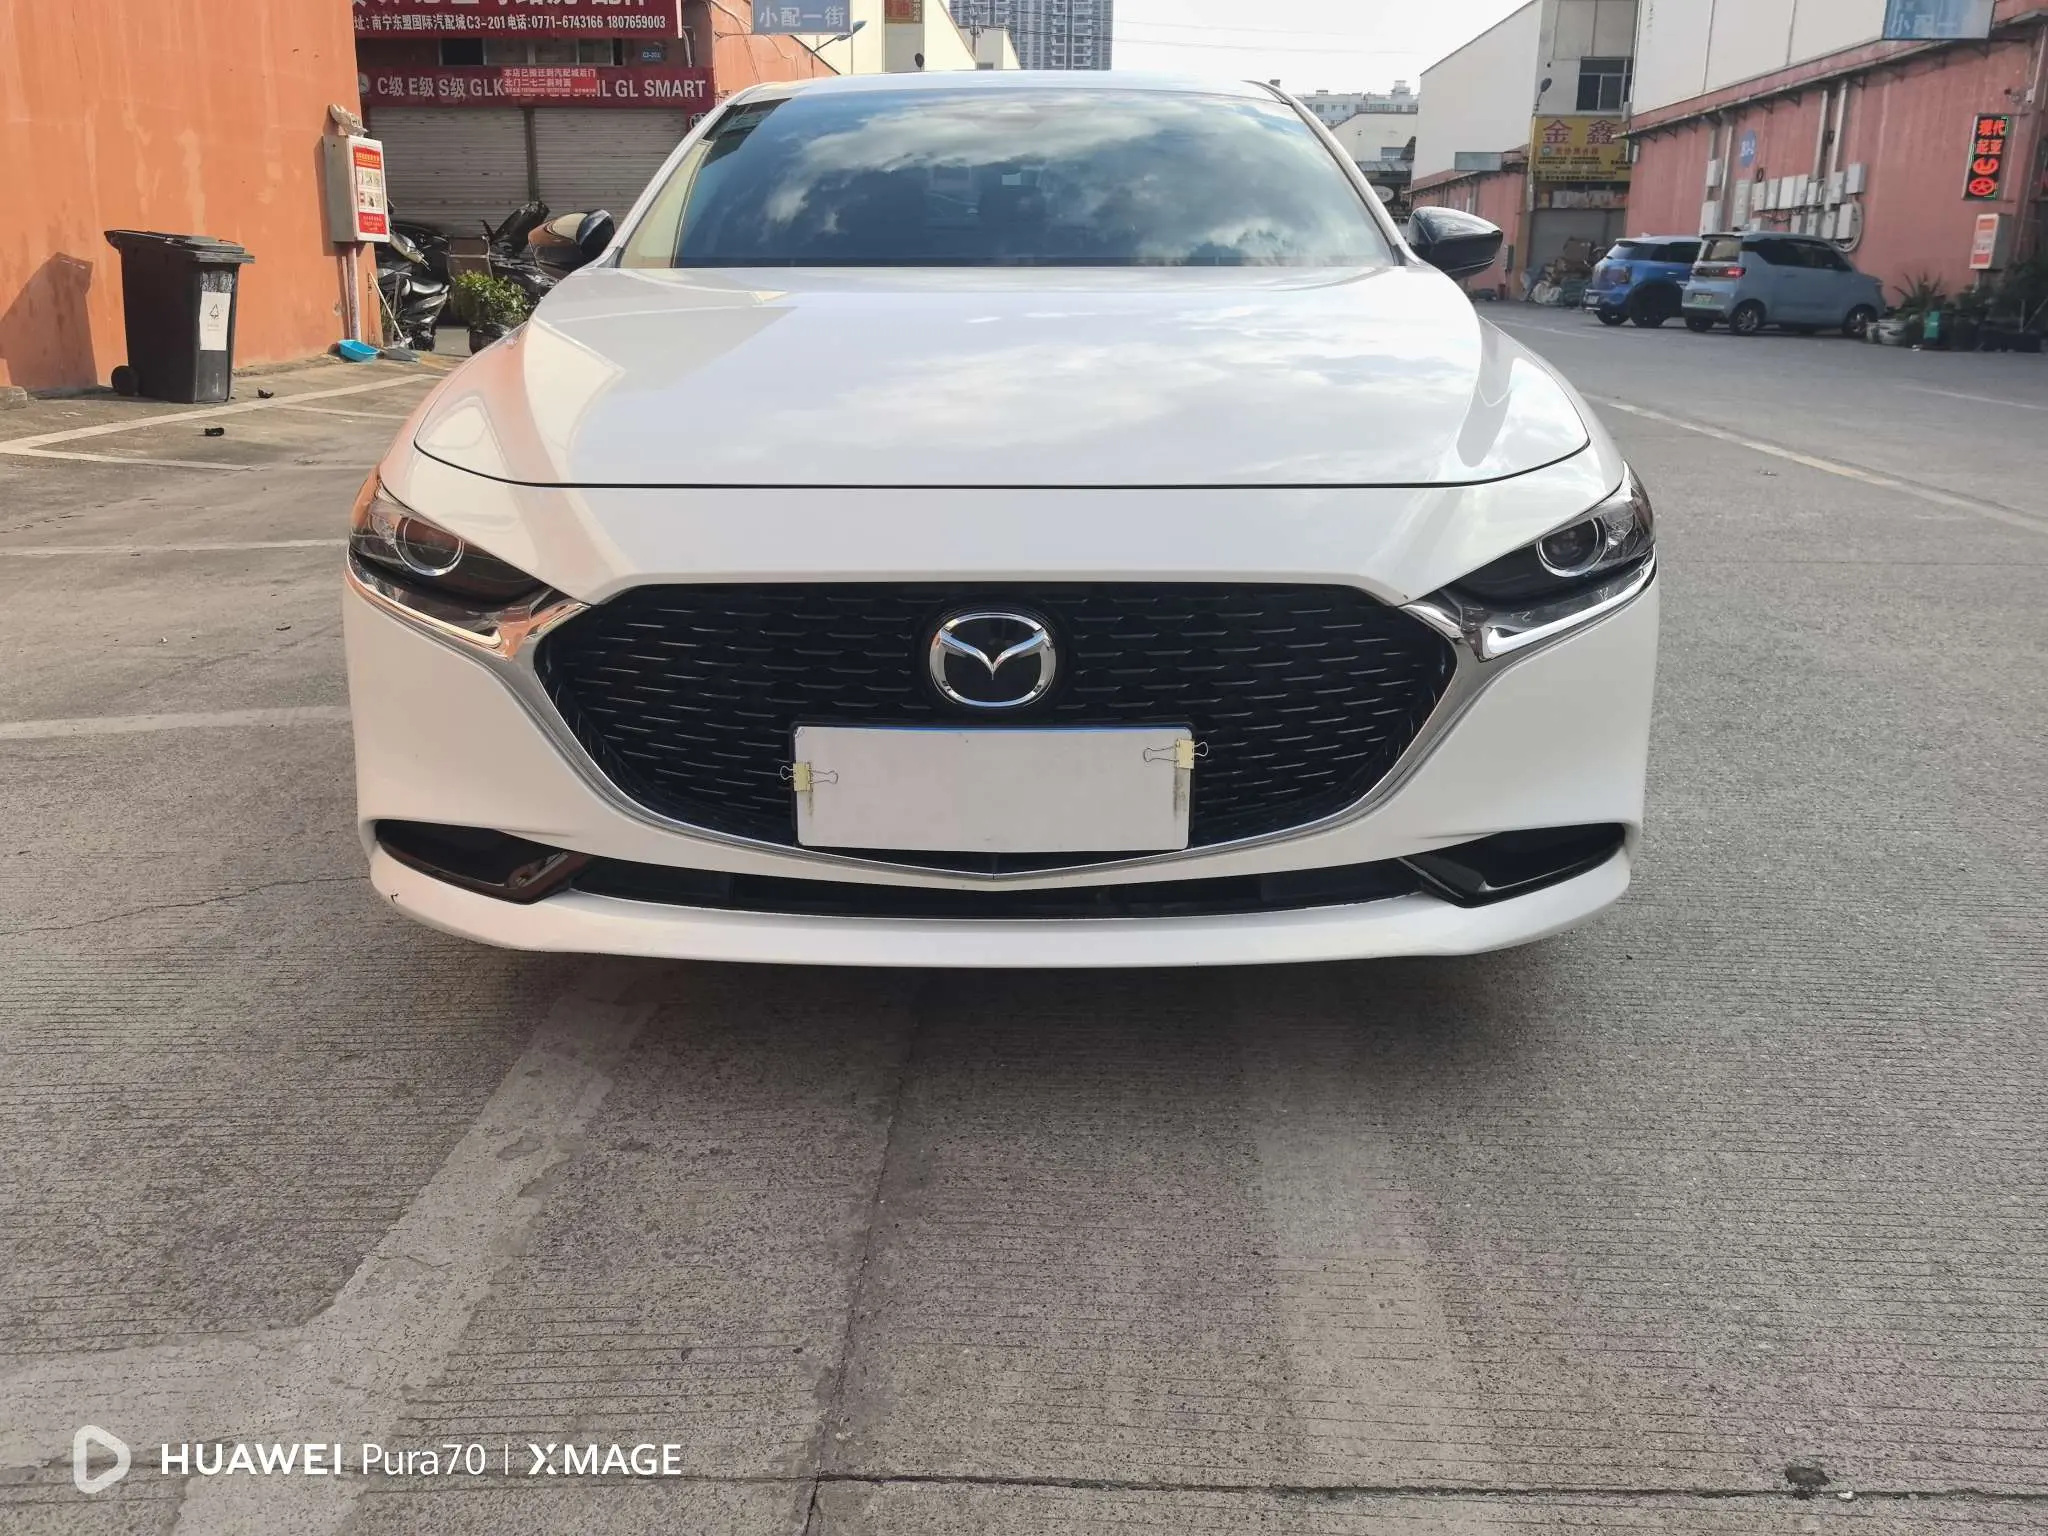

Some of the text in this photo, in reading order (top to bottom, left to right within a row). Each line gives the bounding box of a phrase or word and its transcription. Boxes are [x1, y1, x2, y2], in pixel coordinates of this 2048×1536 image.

[759, 6, 845, 28] 小配一街
[377, 77, 404, 97] C级
[408, 77, 434, 97] E级
[438, 77, 466, 97] S级
[470, 78, 505, 96] GLK
[615, 79, 638, 97] GL
[644, 79, 706, 97] SMART
